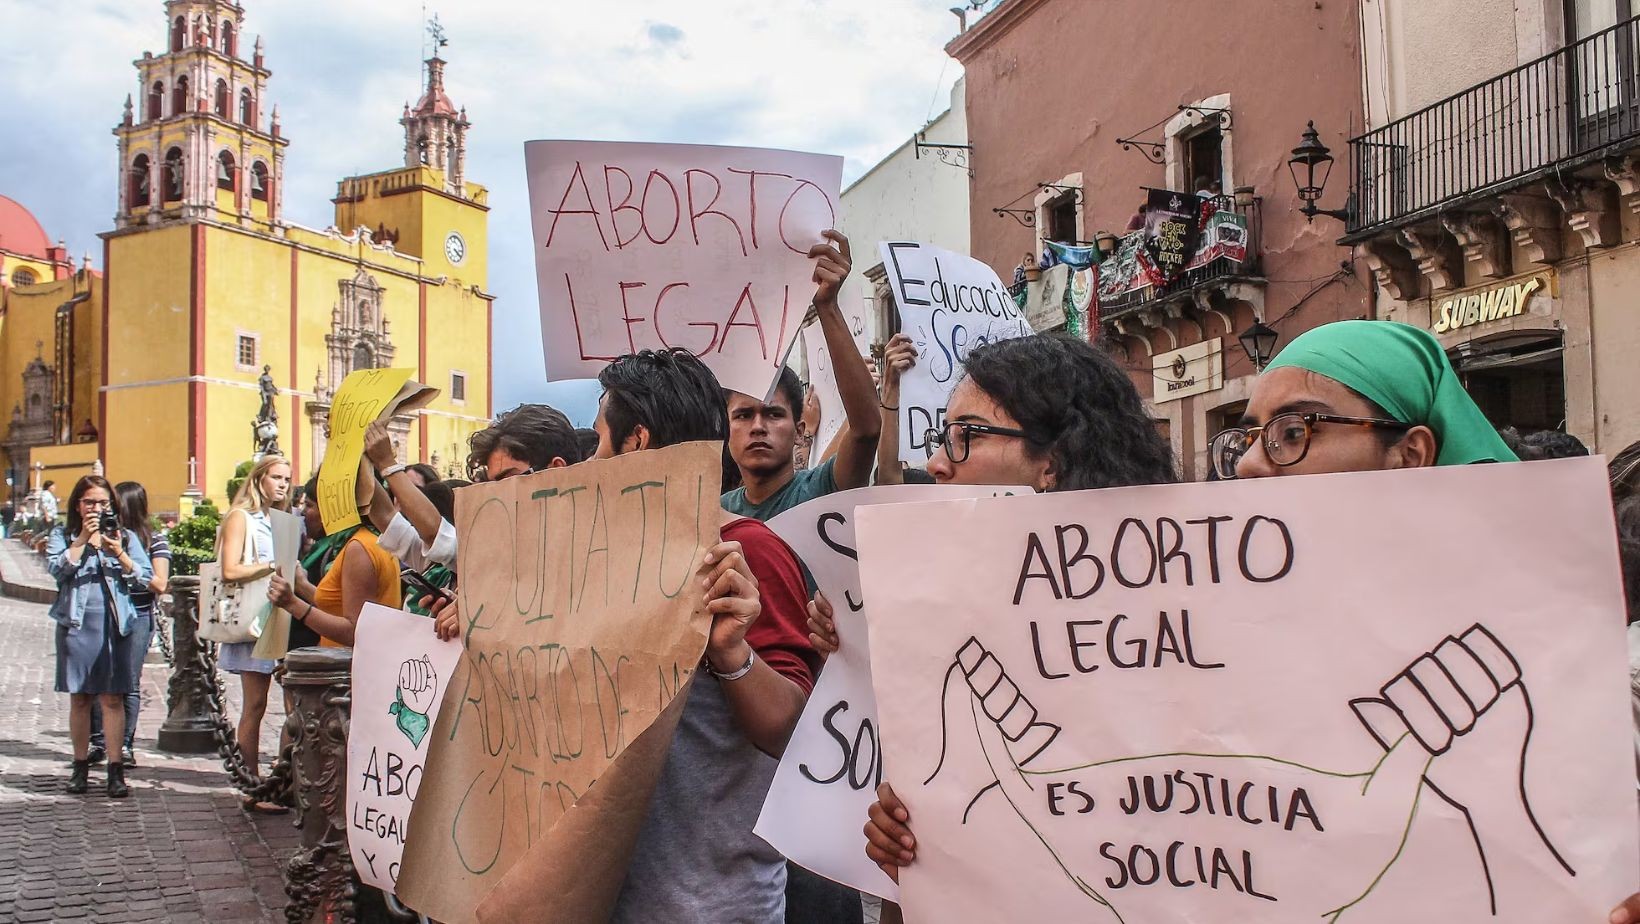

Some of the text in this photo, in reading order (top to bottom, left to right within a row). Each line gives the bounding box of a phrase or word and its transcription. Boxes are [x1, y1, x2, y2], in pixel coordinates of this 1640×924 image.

[546, 160, 835, 256] ABORTO
[1161, 221, 1187, 236] ROCK
[1433, 276, 1541, 333] SUBWAY
[620, 474, 703, 599] TU
[1012, 514, 1295, 606] ABORTO
[1029, 609, 1225, 680] LEGAL
[1046, 769, 1324, 832] ES JUSTICIA
[361, 847, 379, 879] Y
[1099, 840, 1278, 901] SOCIAL
